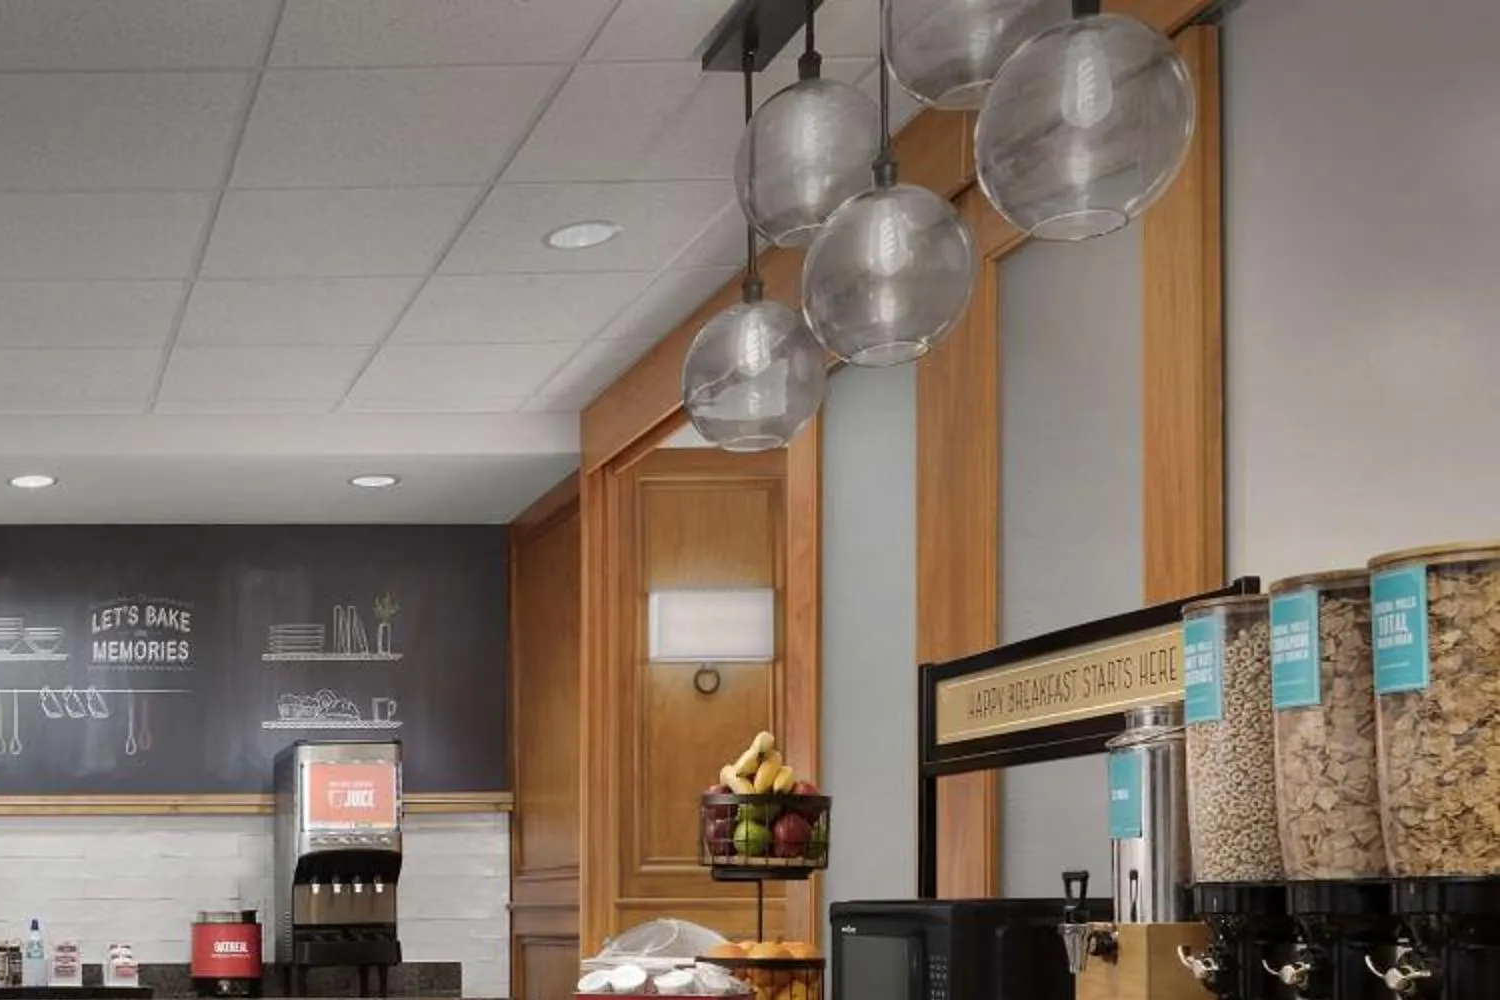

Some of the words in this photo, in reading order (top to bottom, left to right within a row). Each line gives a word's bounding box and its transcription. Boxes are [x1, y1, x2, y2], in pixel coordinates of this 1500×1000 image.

[91, 605, 139, 634] LET'S
[146, 605, 191, 632] BAKE
[93, 640, 189, 661] MEMORIES
[967, 686, 1003, 719] HAPPY
[1007, 669, 1077, 713] BREAKFAST
[1083, 656, 1134, 698] STARTS
[1139, 646, 1177, 686] HERE
